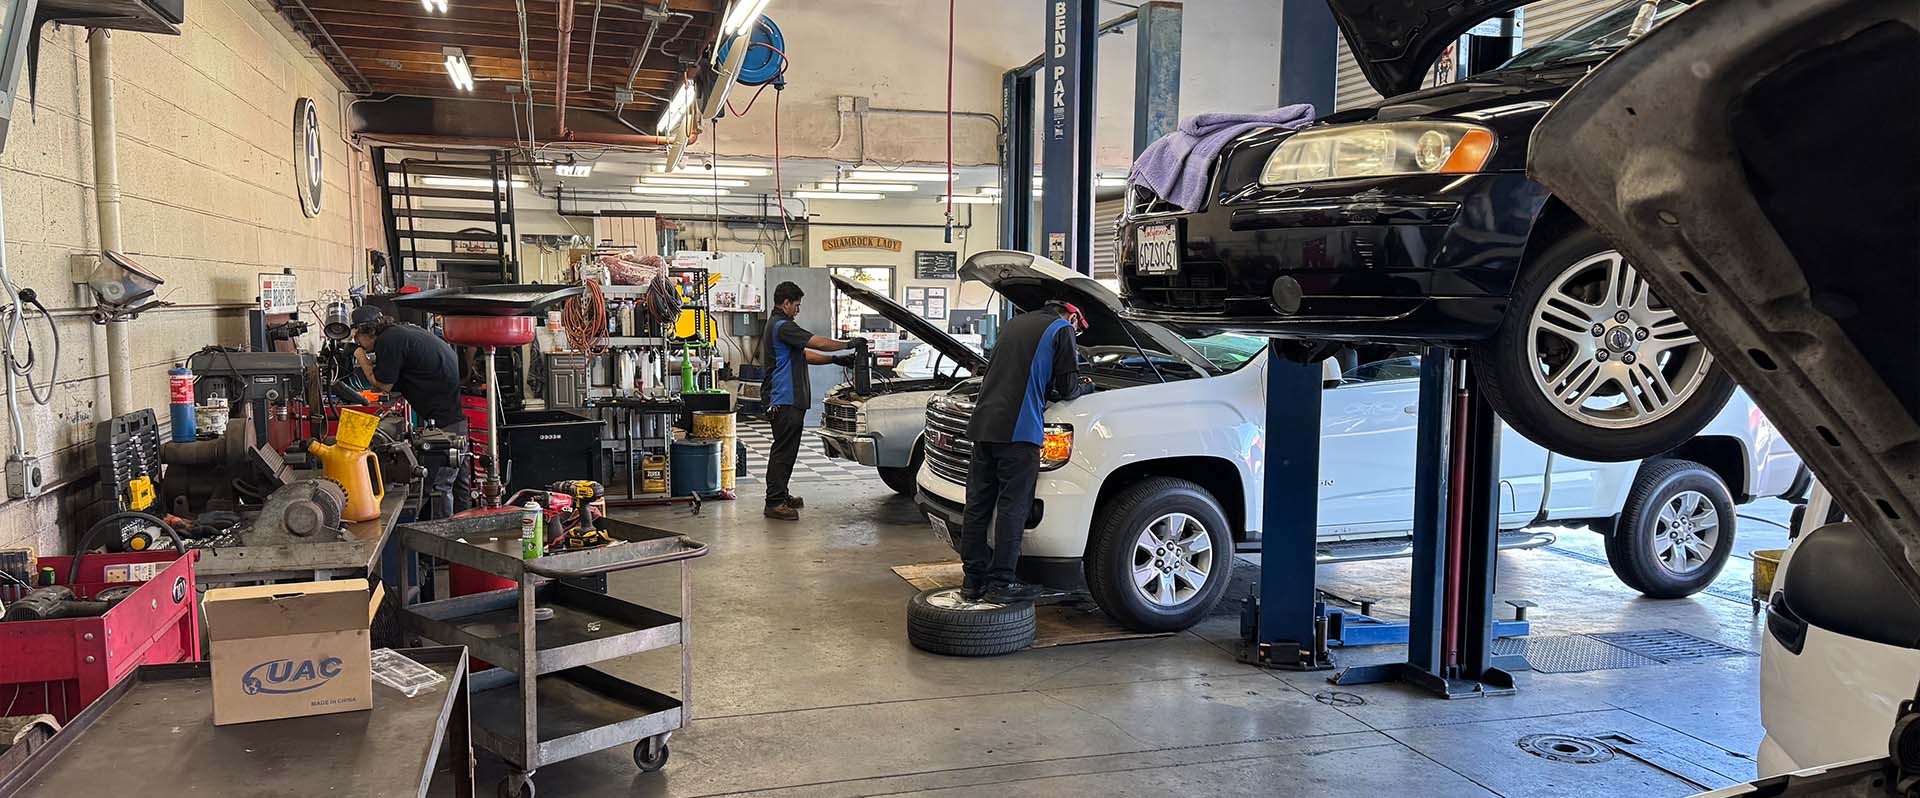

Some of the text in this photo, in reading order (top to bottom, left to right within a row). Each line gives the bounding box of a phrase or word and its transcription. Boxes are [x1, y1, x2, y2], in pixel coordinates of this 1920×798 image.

[1054, 1, 1066, 59] BEND
[1053, 65, 1065, 108] PAK
[828, 236, 898, 250] SHAMROCK LADY
[266, 657, 343, 684] UAC
